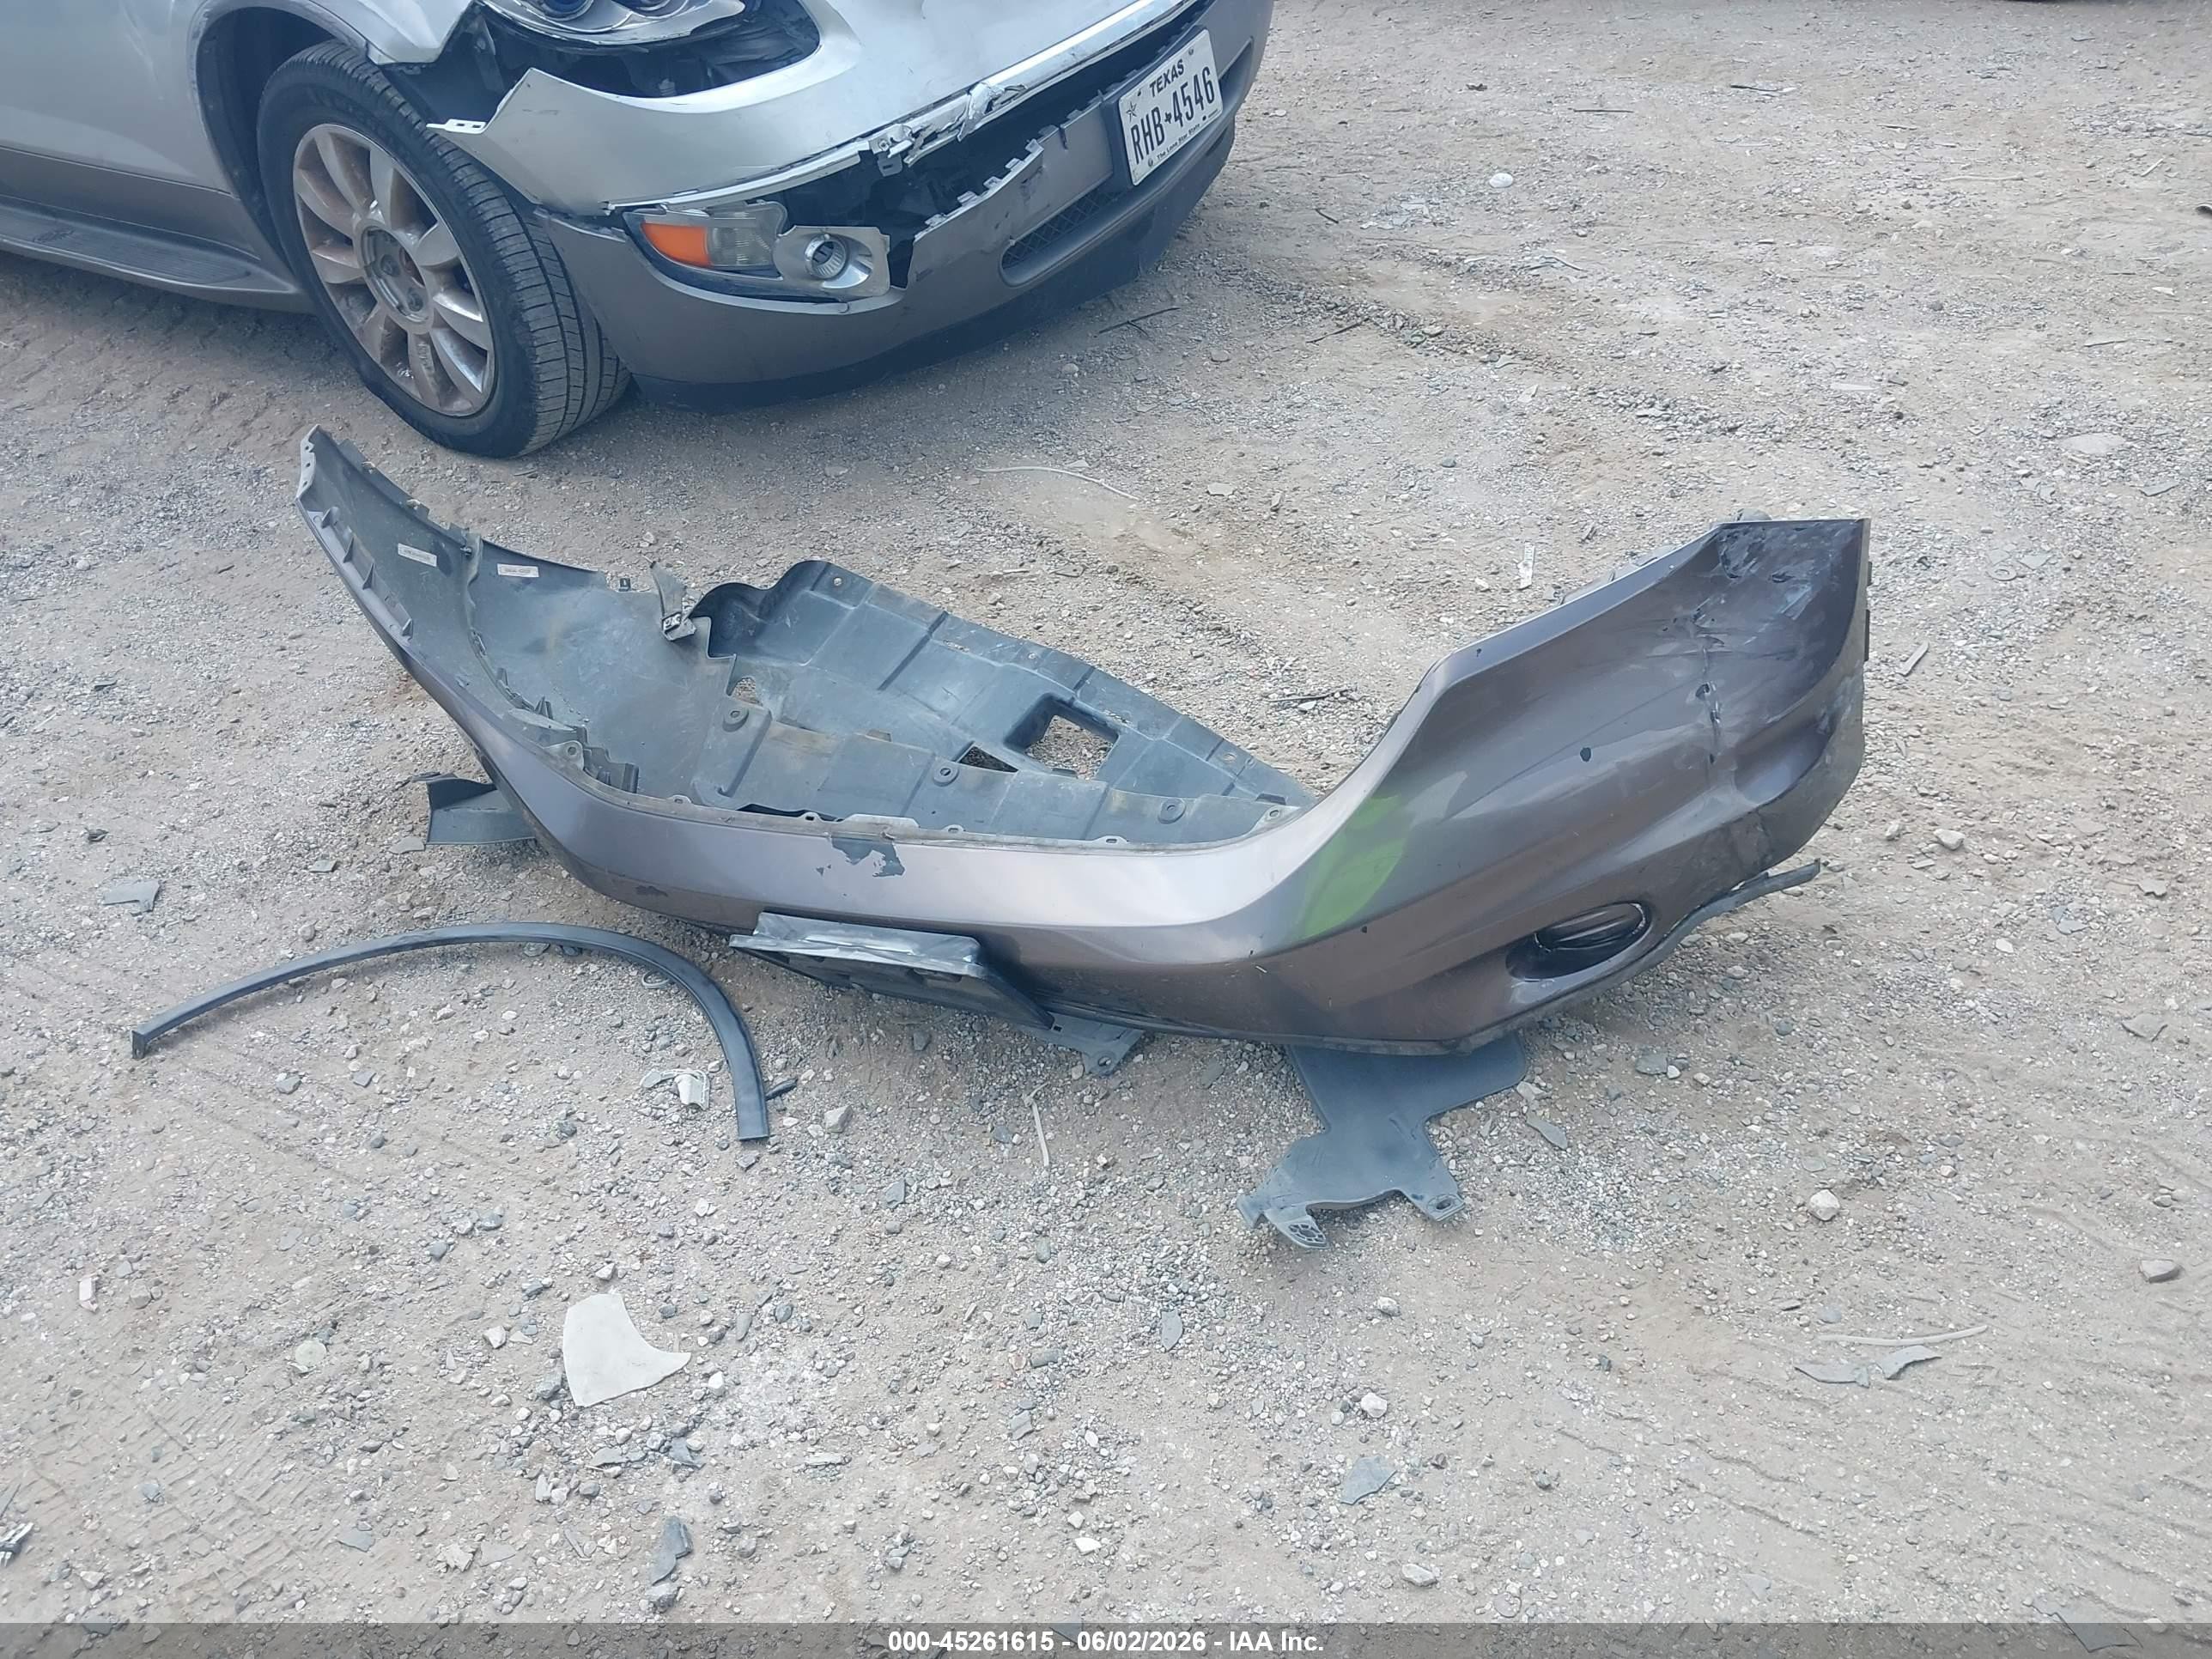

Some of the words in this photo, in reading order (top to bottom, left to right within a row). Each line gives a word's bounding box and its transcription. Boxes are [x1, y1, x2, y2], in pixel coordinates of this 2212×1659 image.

[1149, 58, 1185, 98] TEXAS
[1157, 151, 1166, 160] The
[1166, 142, 1177, 153] Lone
[1178, 134, 1188, 144] Star
